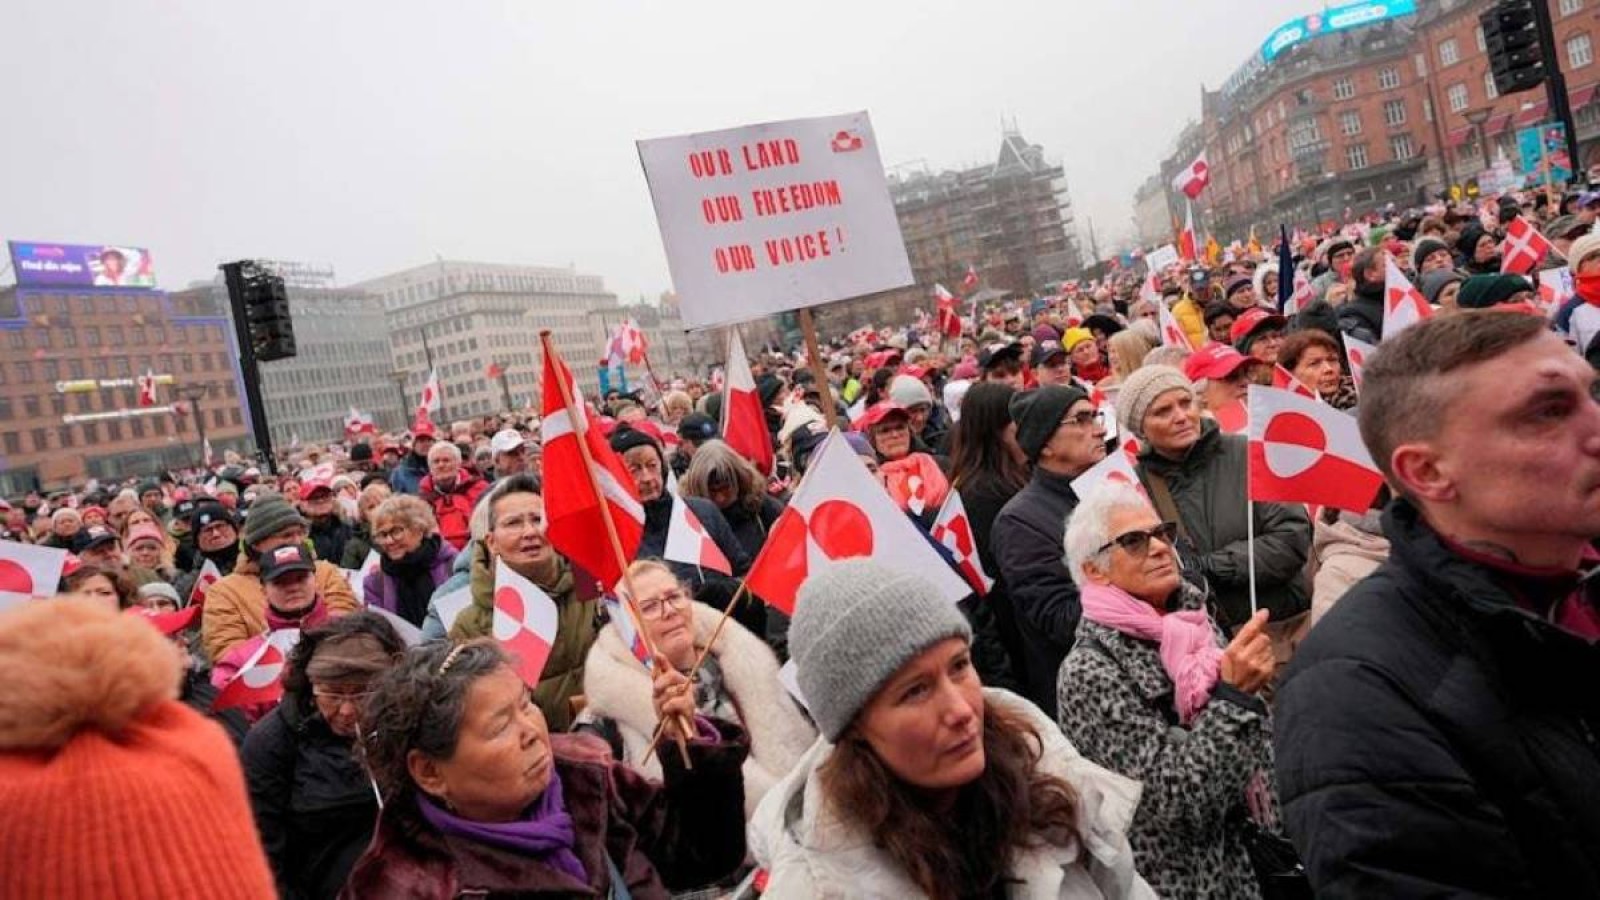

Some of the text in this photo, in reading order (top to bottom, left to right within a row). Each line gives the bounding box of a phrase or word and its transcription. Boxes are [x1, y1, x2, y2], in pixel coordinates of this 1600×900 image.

[689, 139, 799, 177] OUR LAND
[702, 180, 841, 223] OUR FREEDOM
[715, 245, 755, 272] OUR
